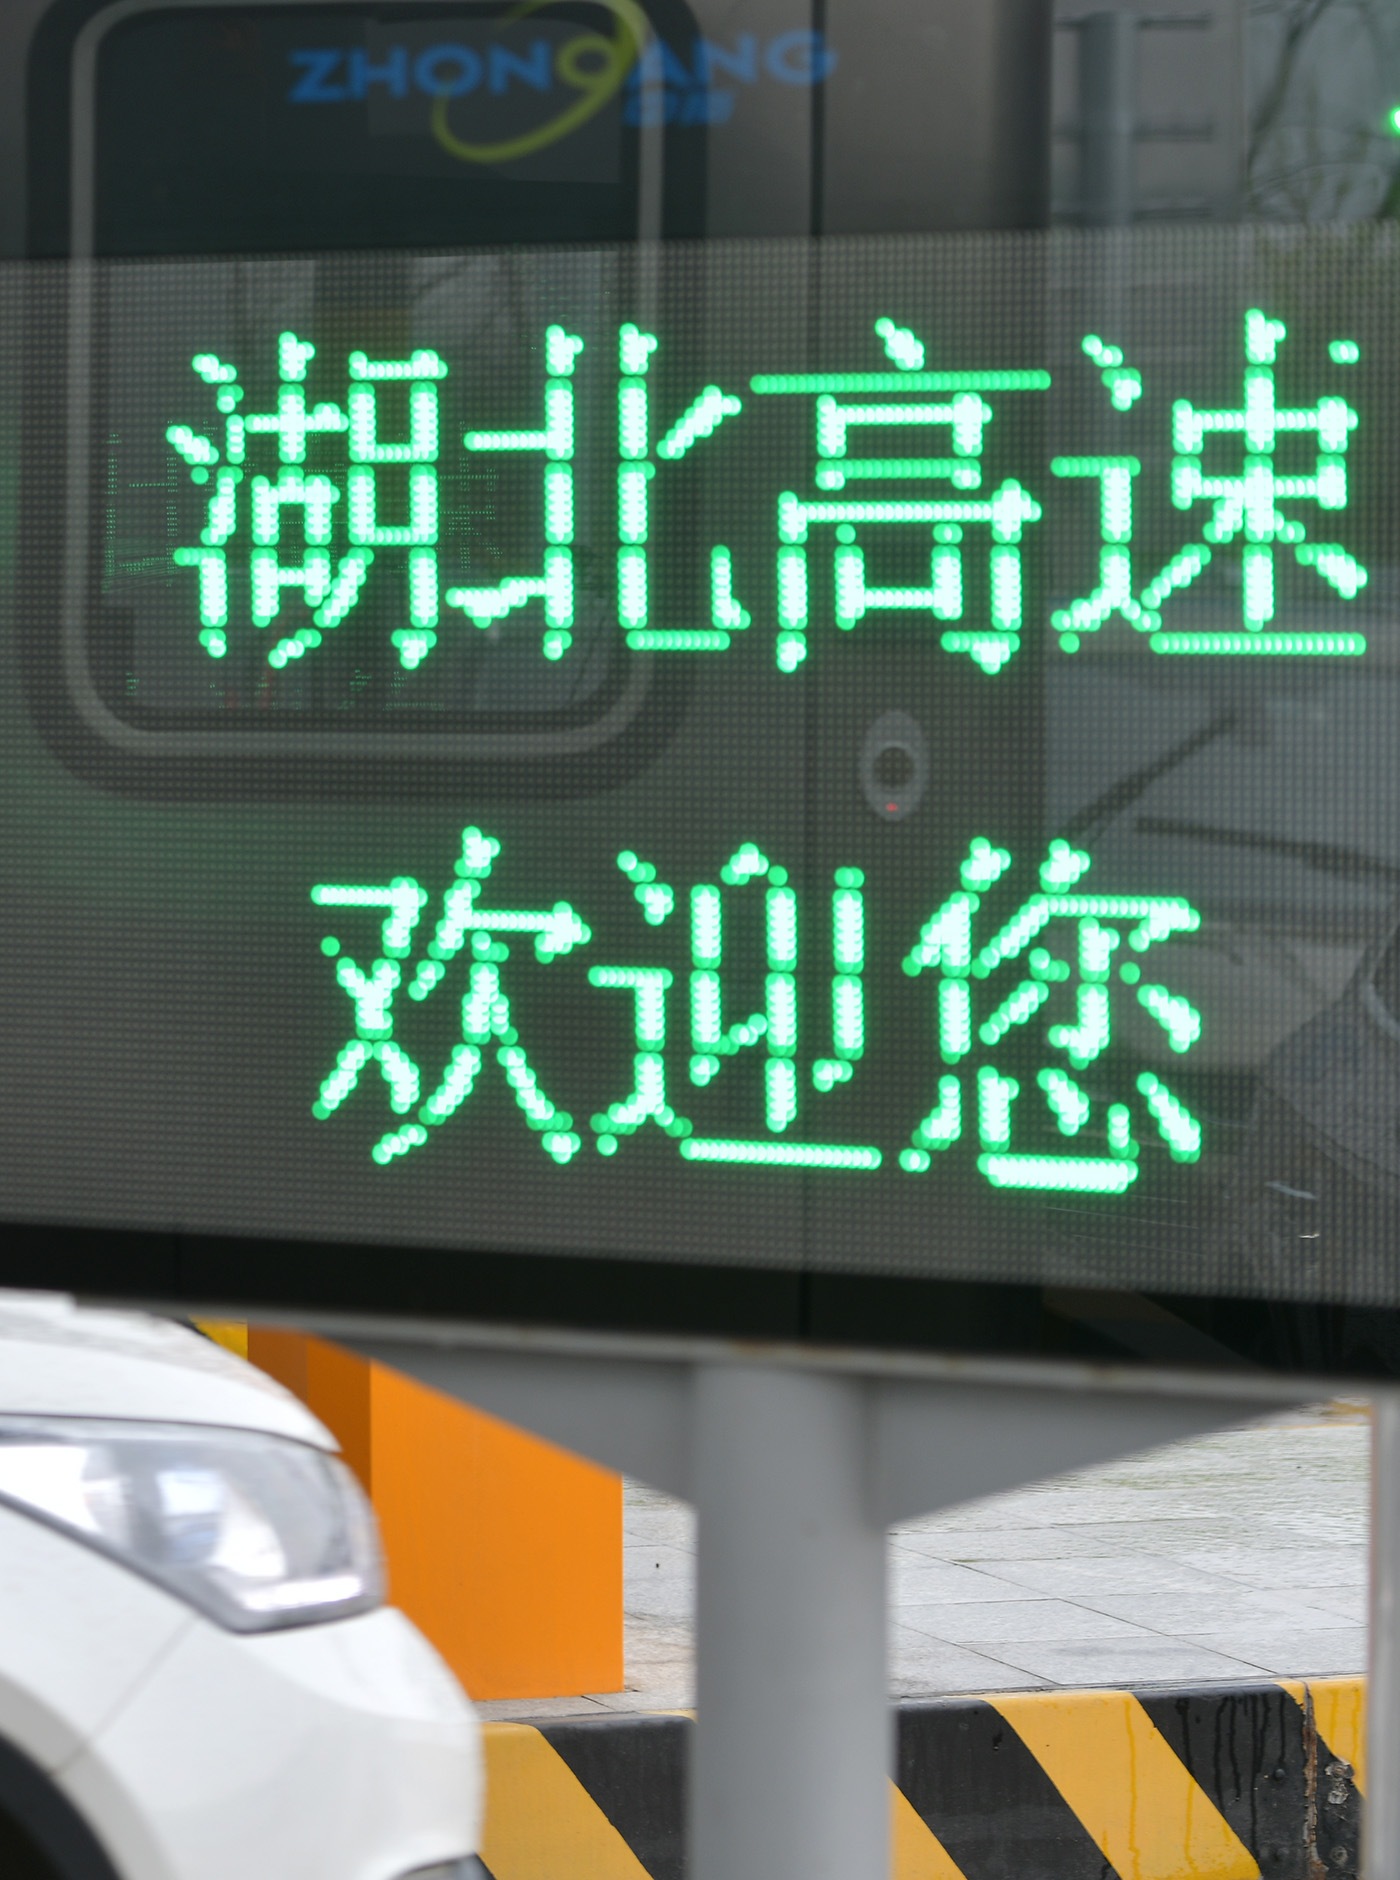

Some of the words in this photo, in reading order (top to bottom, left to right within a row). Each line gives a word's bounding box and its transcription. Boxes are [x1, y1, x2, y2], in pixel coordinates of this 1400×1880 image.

[165, 306, 1370, 677] 湖北高速
[310, 824, 1204, 1196] 欢迎您
